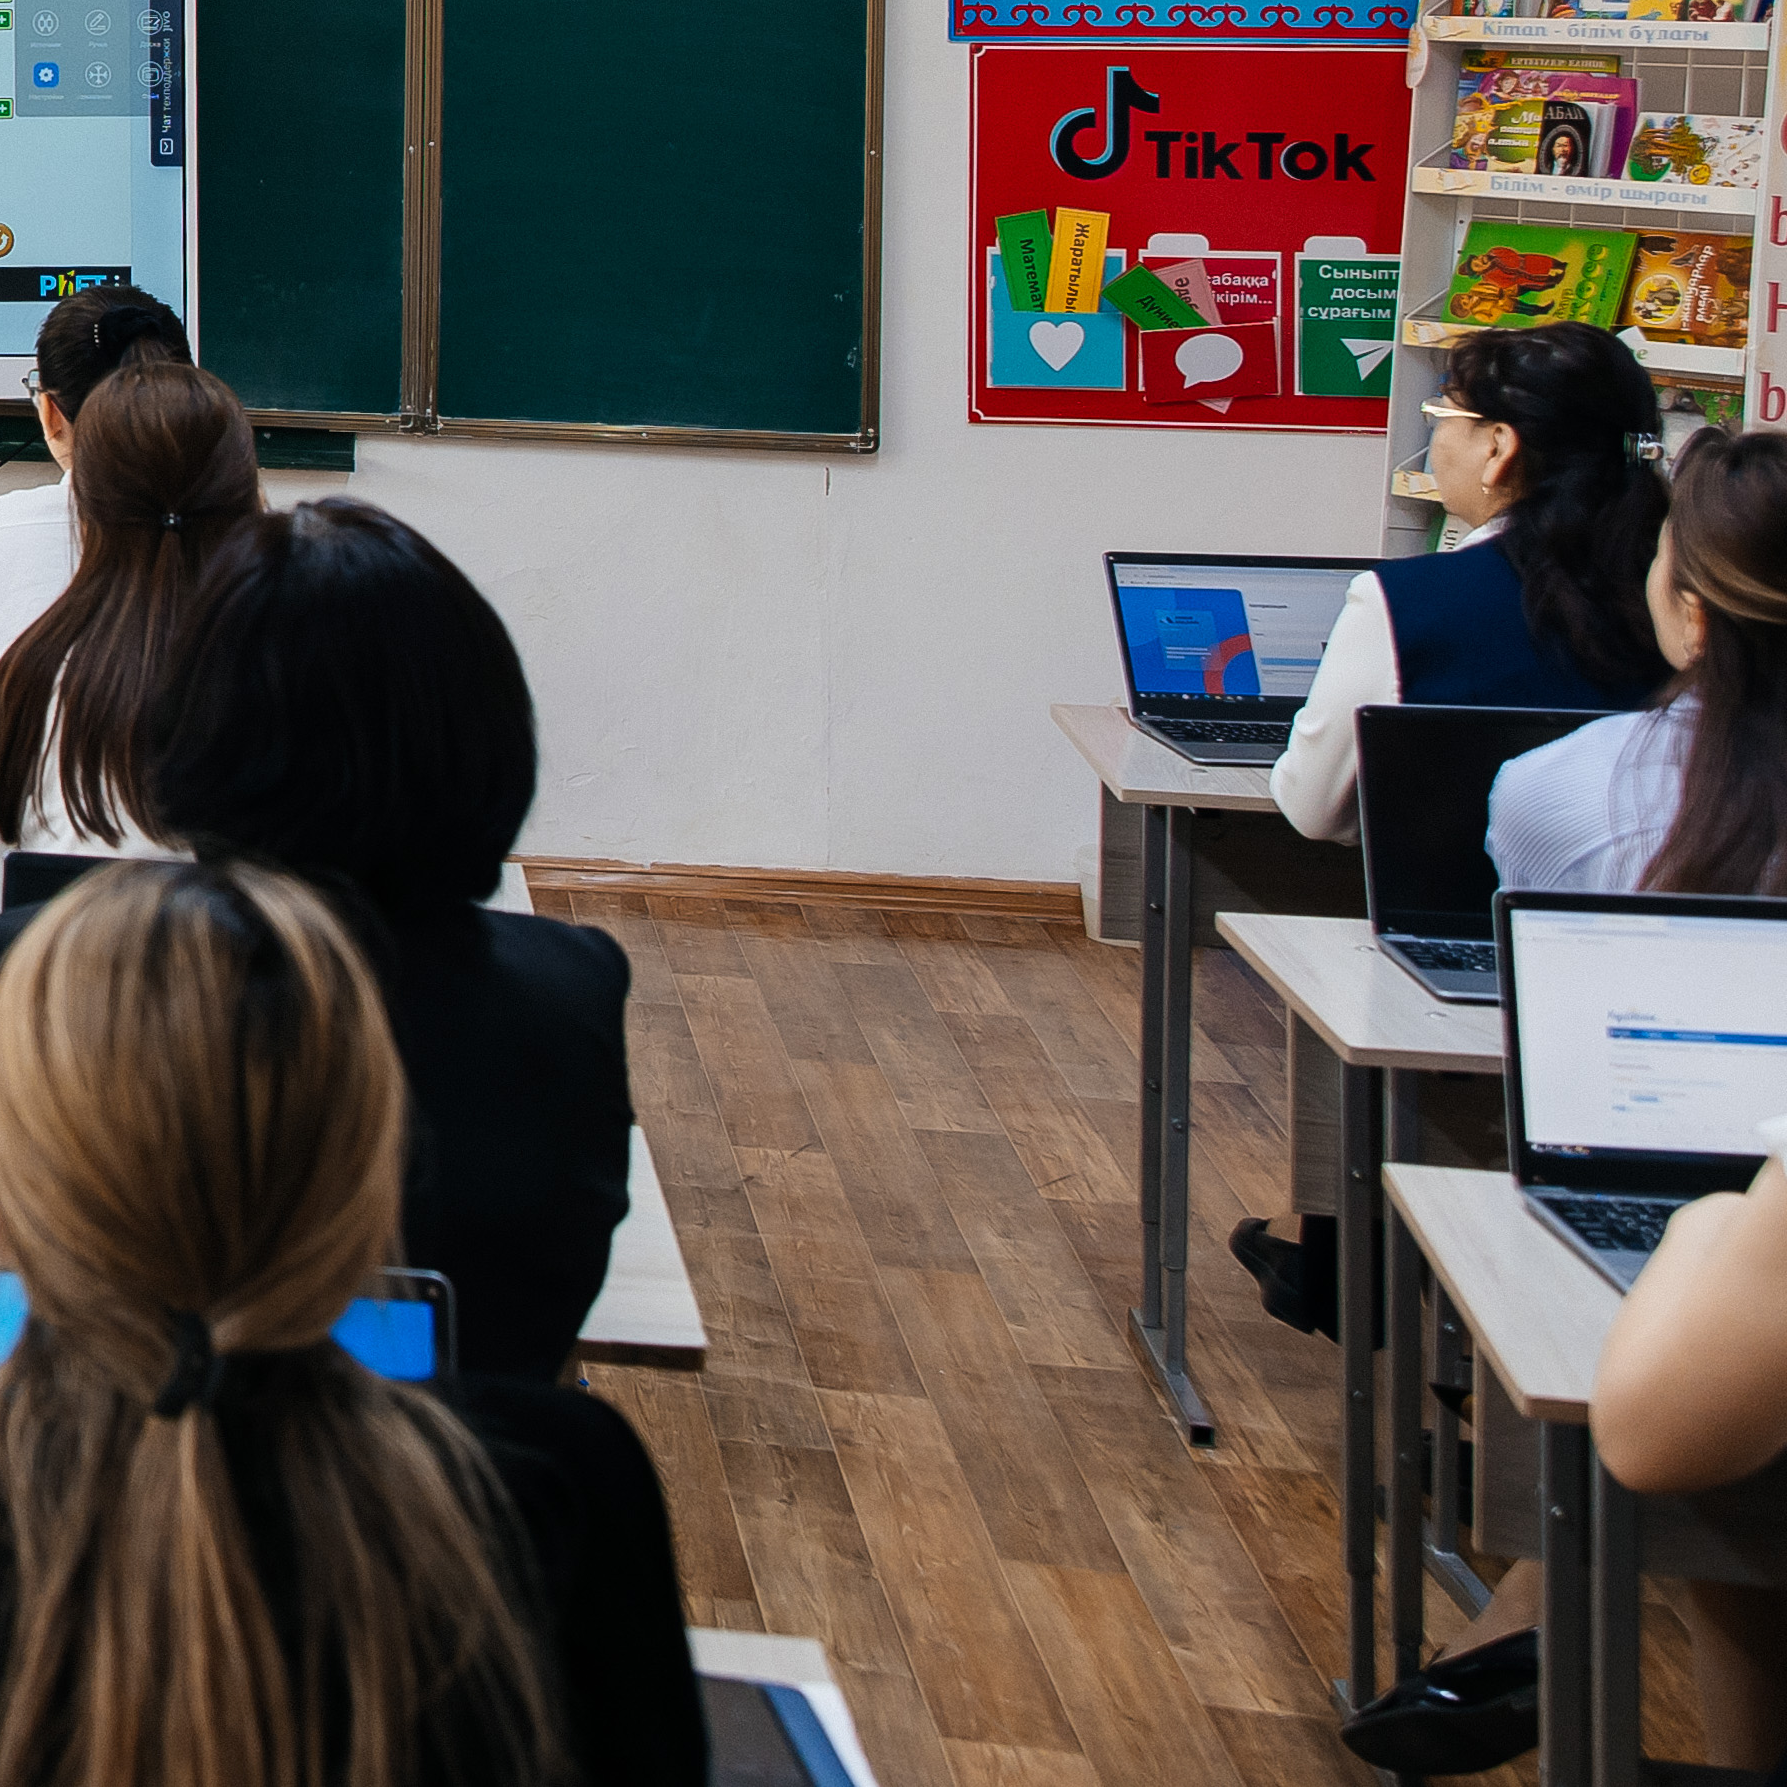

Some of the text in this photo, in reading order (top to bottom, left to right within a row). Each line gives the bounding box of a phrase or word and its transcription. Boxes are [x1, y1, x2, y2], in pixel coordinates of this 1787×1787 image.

[1567, 18, 1624, 39] білім
[1629, 25, 1709, 43] бұлағы
[1145, 130, 1376, 182] TikTok
[1490, 176, 1708, 205] Білім өмір шырағы
[1020, 239, 1044, 312] Математ
[1319, 264, 1400, 280] Сыныпт
[1212, 291, 1272, 305] ікірім...
[1330, 288, 1398, 300] досым
